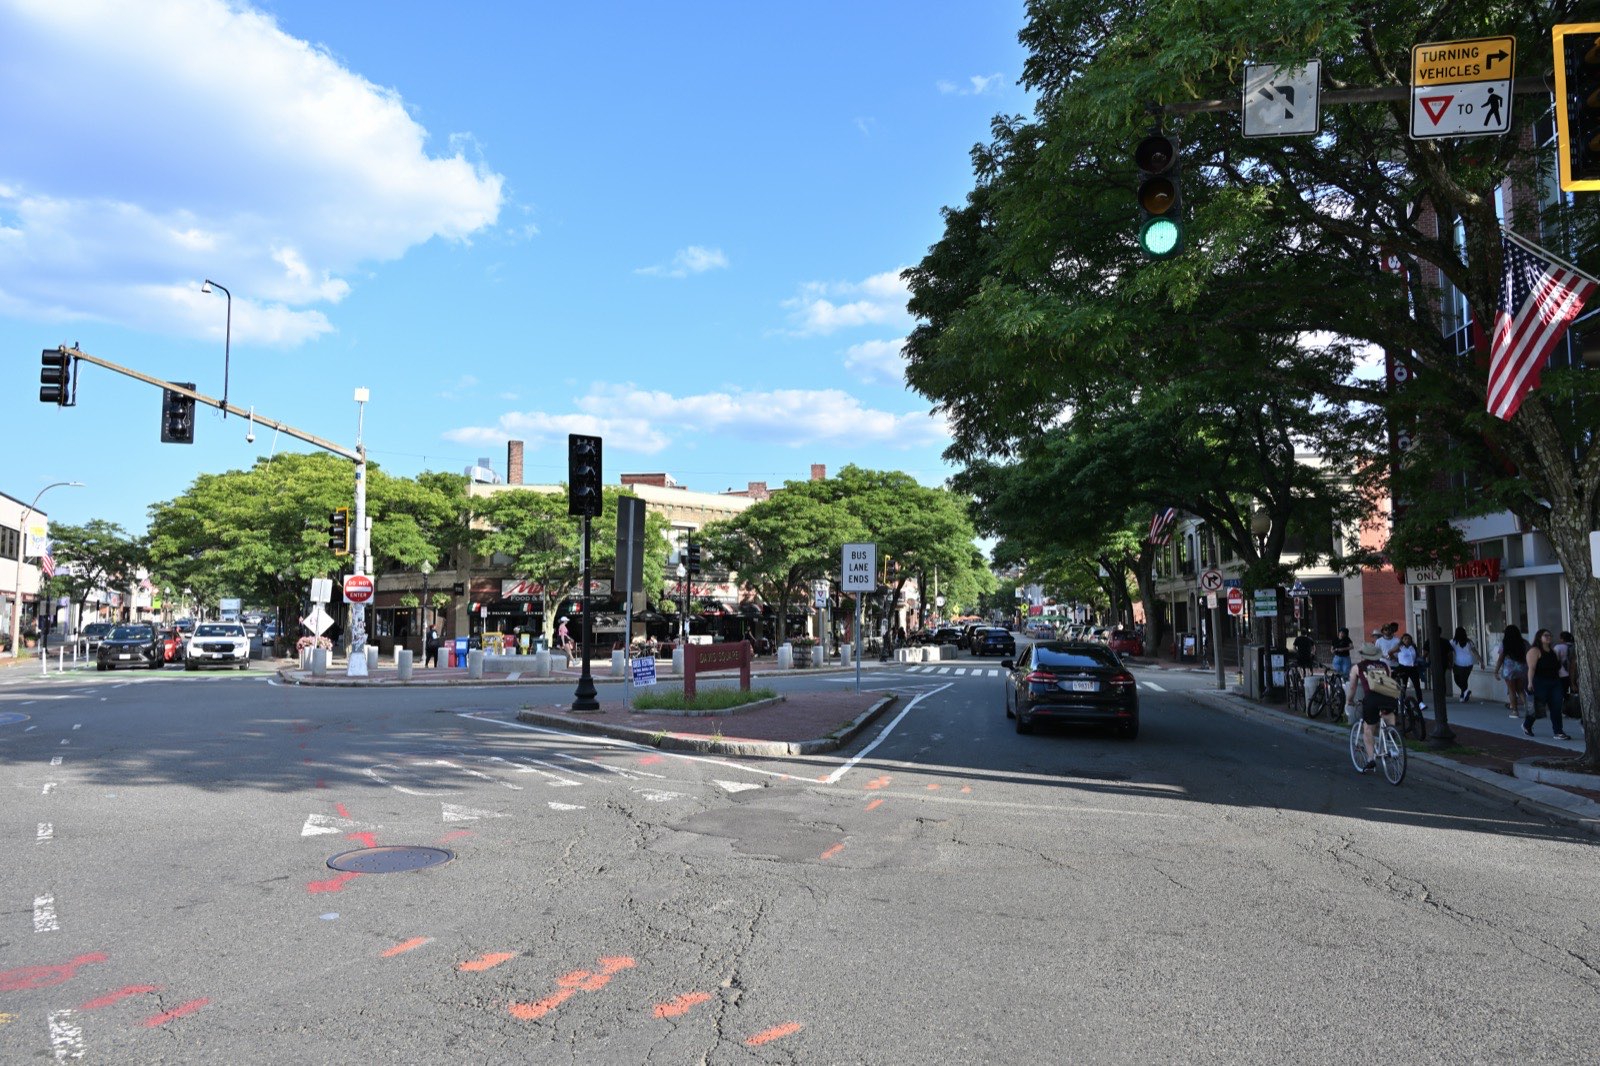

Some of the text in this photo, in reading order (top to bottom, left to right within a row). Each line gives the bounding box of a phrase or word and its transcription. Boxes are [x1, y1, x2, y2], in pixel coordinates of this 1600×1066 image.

[1421, 46, 1479, 62] TURNING
[1419, 64, 1480, 79] VEHICLES
[1457, 103, 1473, 115] TO
[851, 551, 867, 560] BUS
[849, 562, 869, 572] LANE
[848, 574, 869, 583] ENDS
[1416, 571, 1442, 582] ONLY
[700, 651, 739, 664] DAVIS SQUARE
